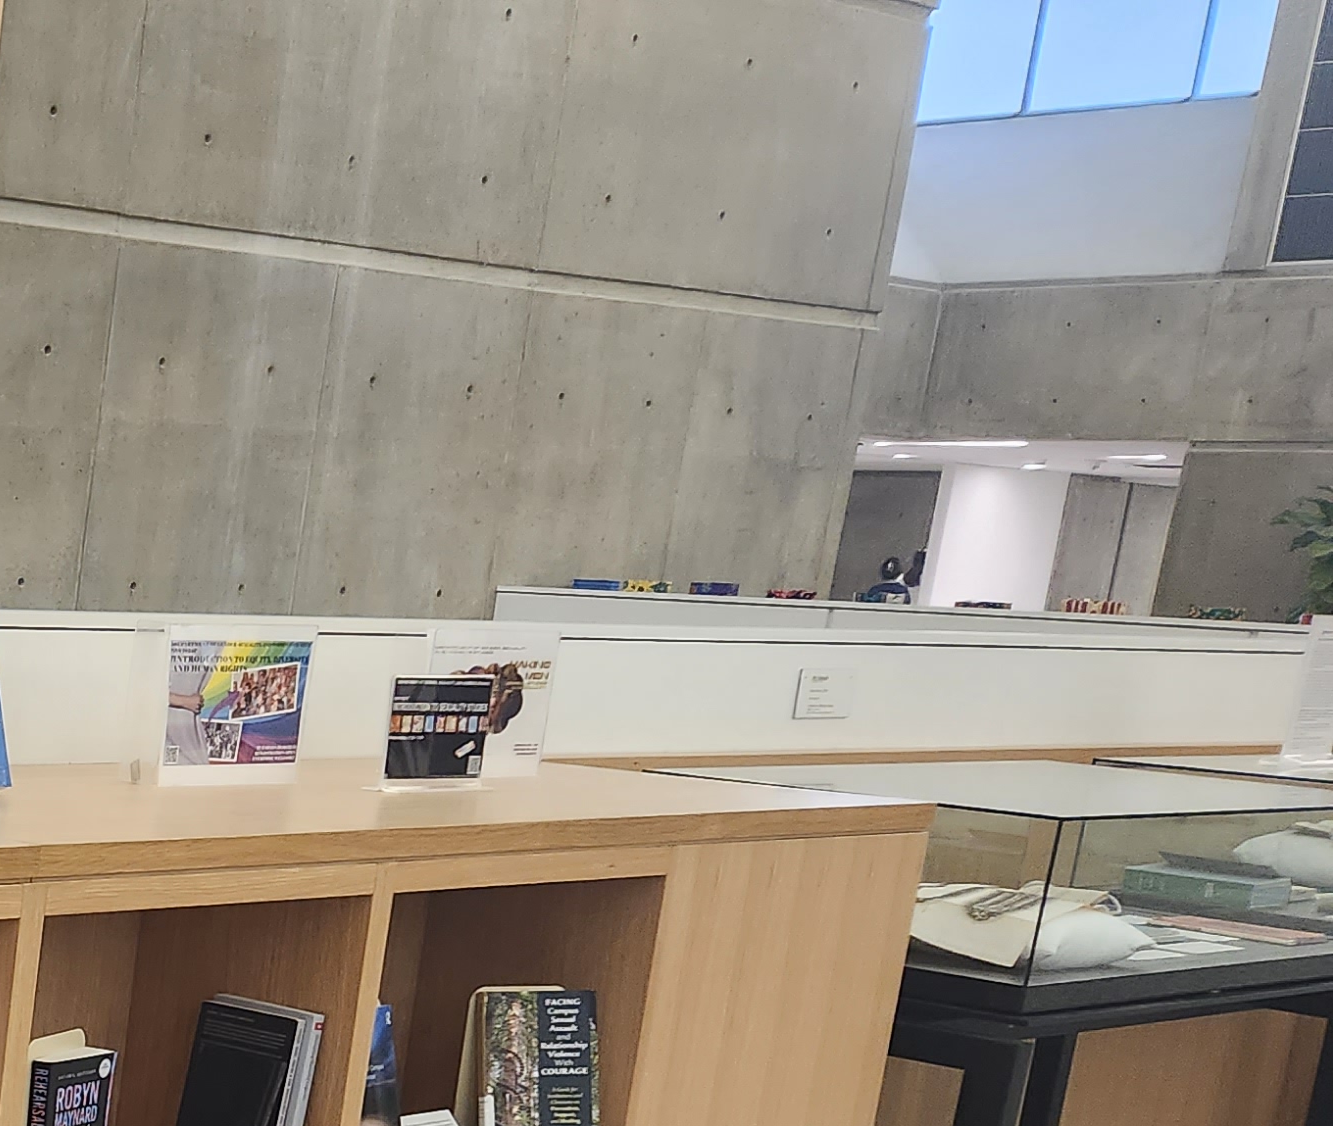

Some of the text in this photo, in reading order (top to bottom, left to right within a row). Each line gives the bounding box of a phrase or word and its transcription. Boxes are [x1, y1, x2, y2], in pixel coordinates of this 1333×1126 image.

[544, 998, 581, 1006] FACING
[540, 1067, 589, 1076] COURAGE
[55, 1081, 100, 1112] ROBYN
